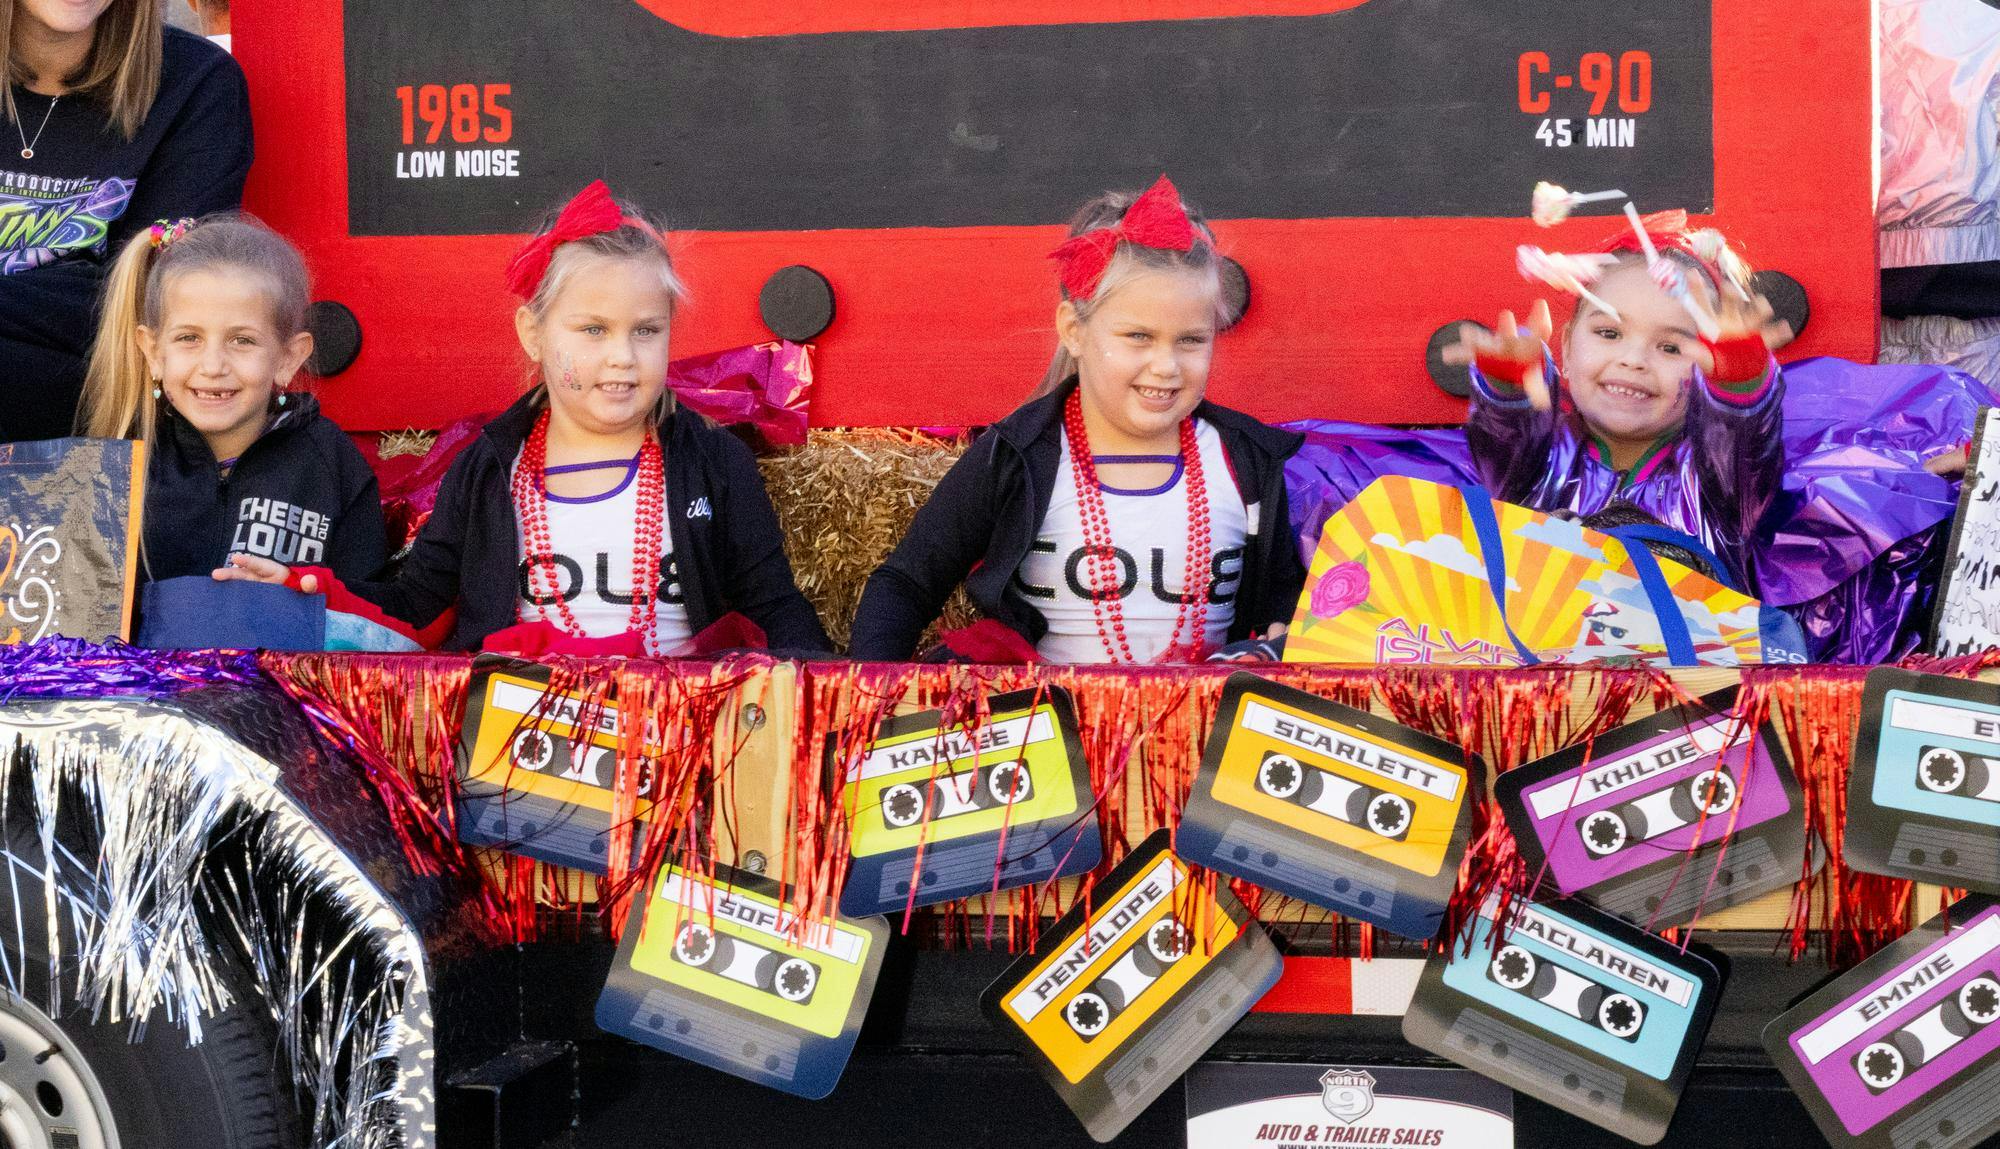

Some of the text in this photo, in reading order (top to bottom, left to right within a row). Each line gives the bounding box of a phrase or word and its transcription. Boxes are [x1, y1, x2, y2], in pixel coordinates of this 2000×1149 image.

[1517, 50, 1652, 115] C-90
[396, 83, 512, 145] 1985
[1535, 118, 1635, 148] 45 MIN
[396, 149, 520, 178] LOW NOISE
[238, 497, 321, 538] CHEER
[318, 514, 331, 540] OUT
[230, 522, 324, 563] LOUD
[1974, 719, 2000, 738] E
[1273, 718, 1438, 788] SCARLETT
[1588, 742, 1698, 793] KHLOE
[1031, 880, 1163, 1001] PENELOPE
[1504, 906, 1671, 994] MACLAREN
[1854, 952, 1954, 1023] EMMIE
[1326, 1075, 1369, 1086] NORTH
[1256, 1123, 1445, 1146] AUTO & TRAILER SALES
